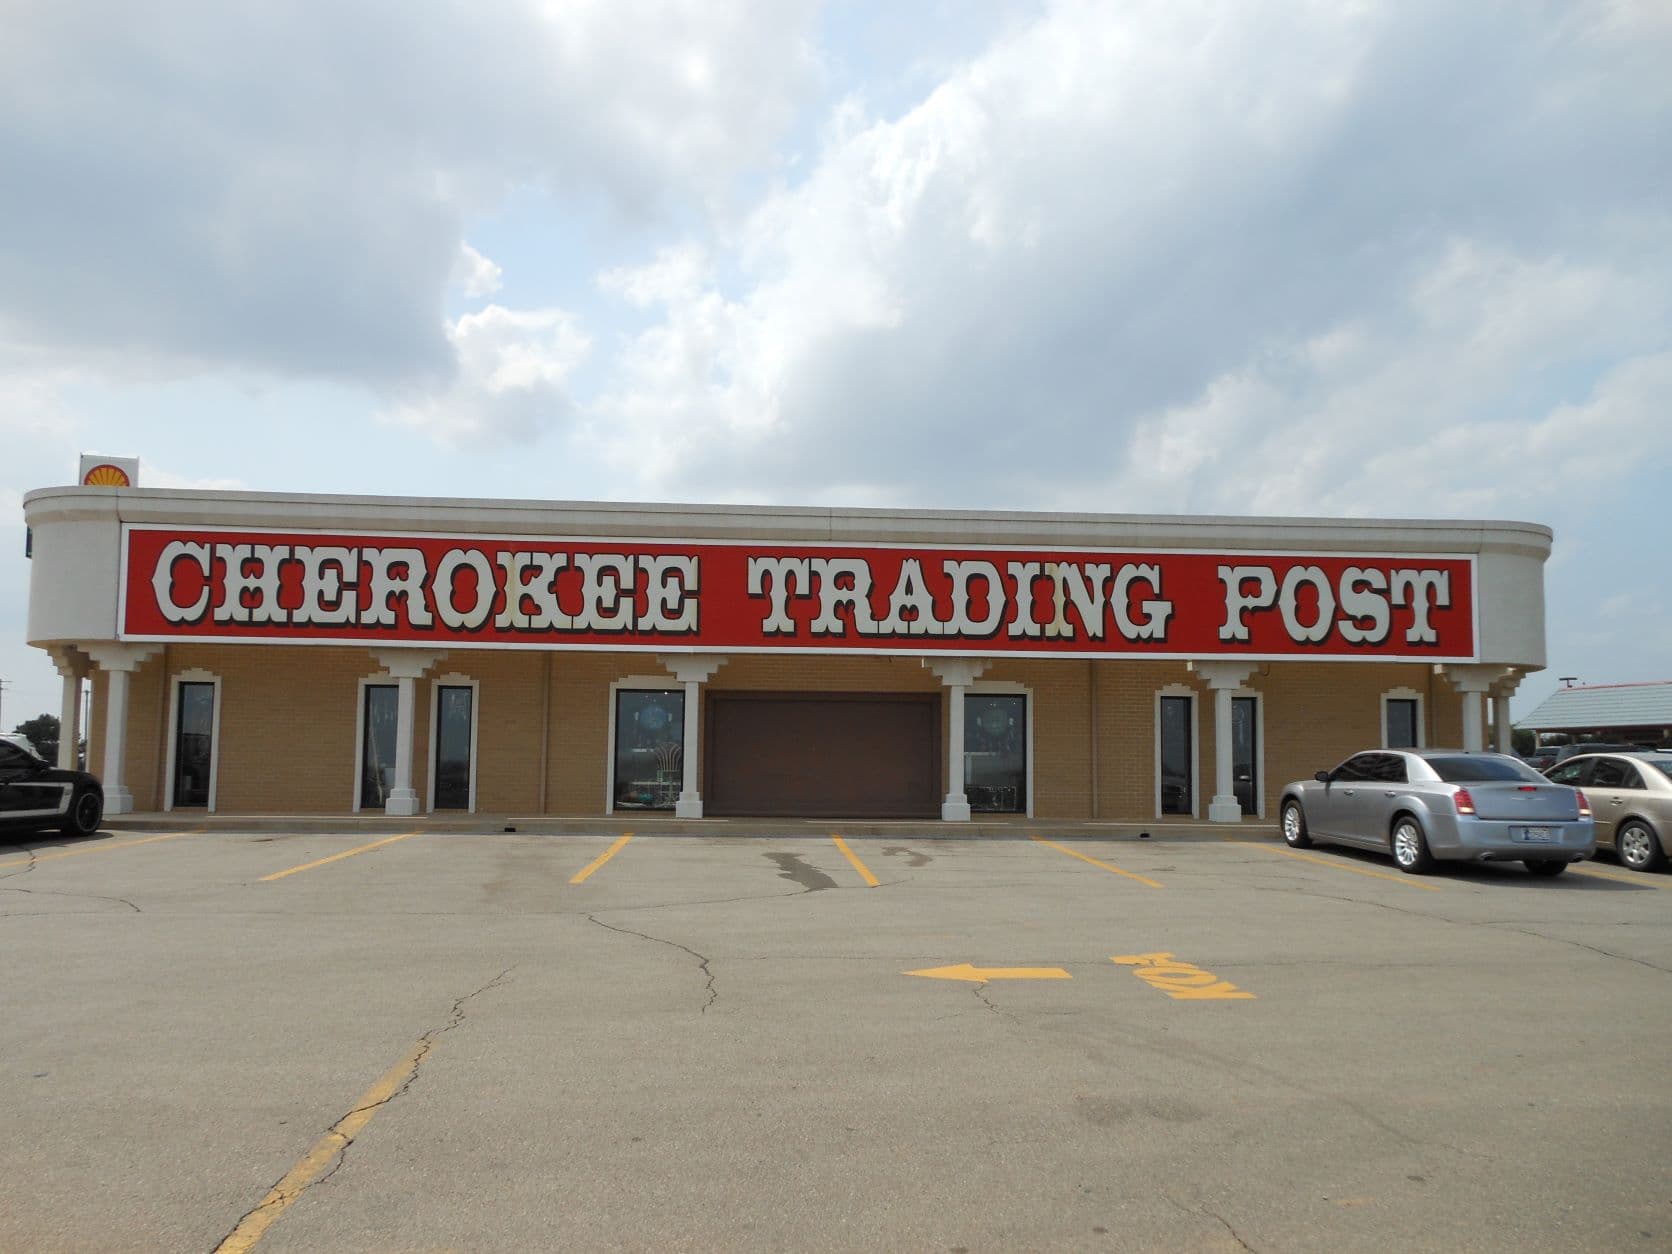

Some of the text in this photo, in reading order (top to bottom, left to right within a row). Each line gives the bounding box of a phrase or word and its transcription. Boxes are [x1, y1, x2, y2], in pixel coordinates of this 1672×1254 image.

[152, 540, 1451, 646] CHEROKEE TRADING POST
